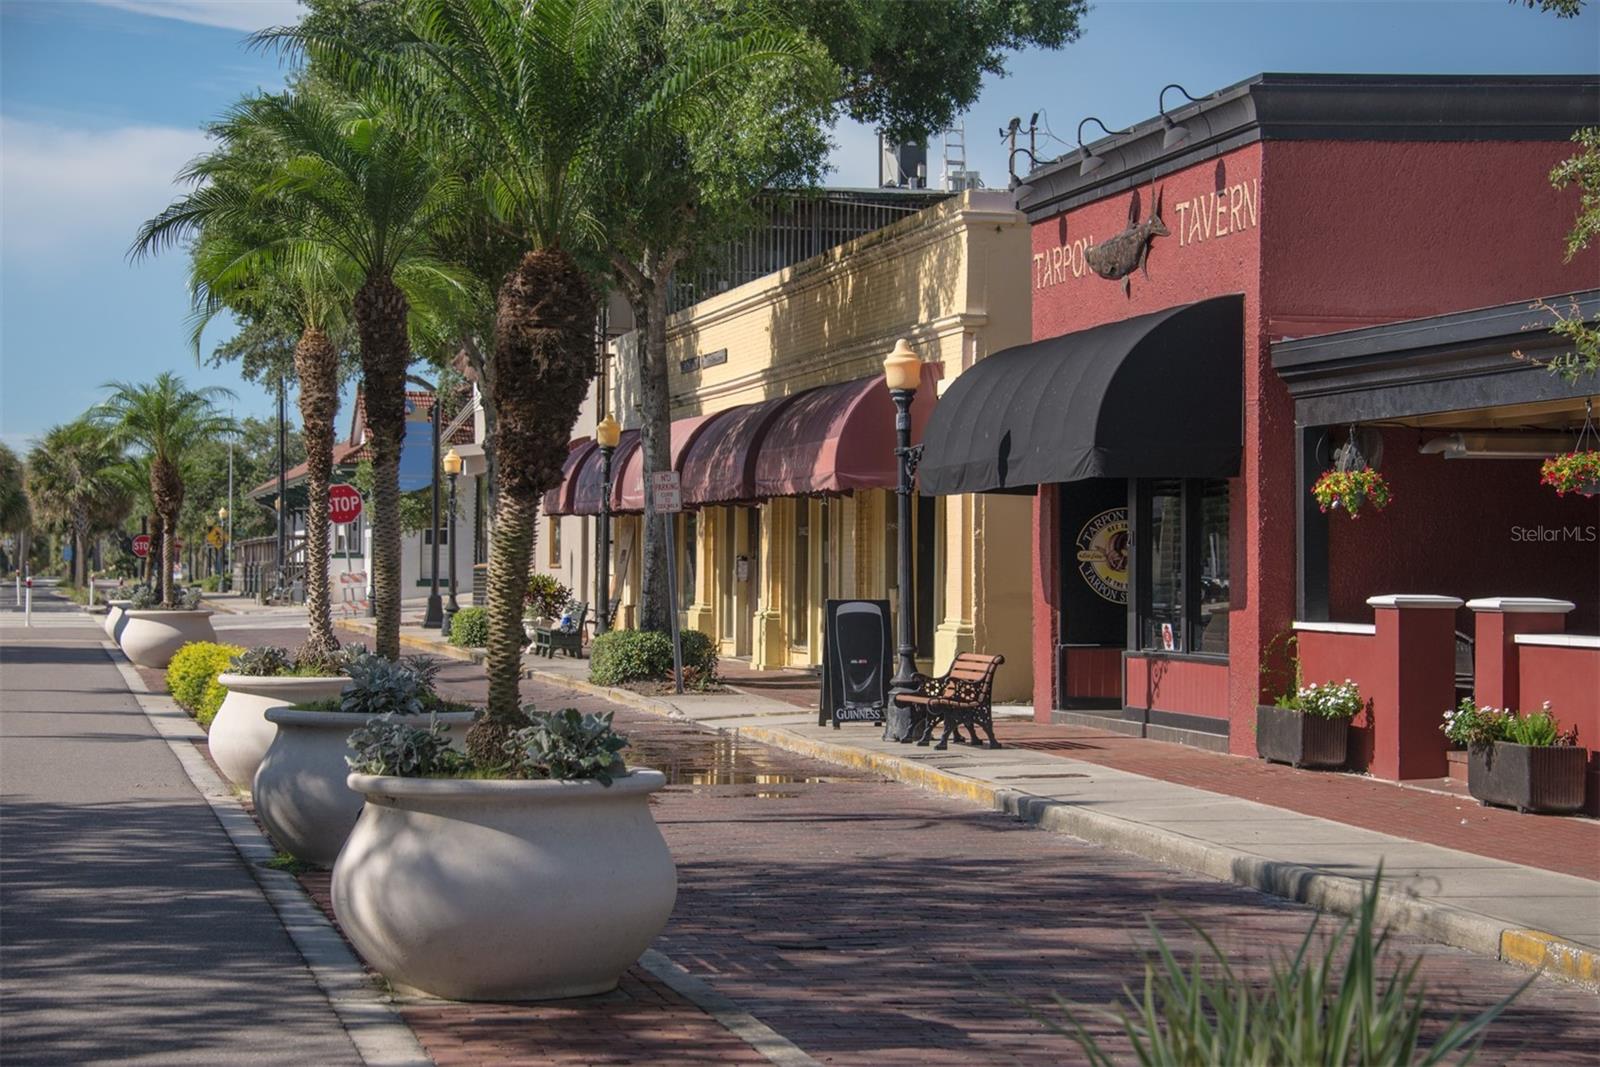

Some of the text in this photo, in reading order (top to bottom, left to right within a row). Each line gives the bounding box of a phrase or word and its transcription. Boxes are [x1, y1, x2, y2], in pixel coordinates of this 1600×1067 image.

[1175, 179, 1258, 247] TAVERN
[328, 496, 360, 512] STOP
[1083, 511, 1125, 541] TARPON
[134, 542, 149, 550] STO
[1085, 566, 1117, 600] TARPON
[836, 708, 881, 720] GUINNESS
